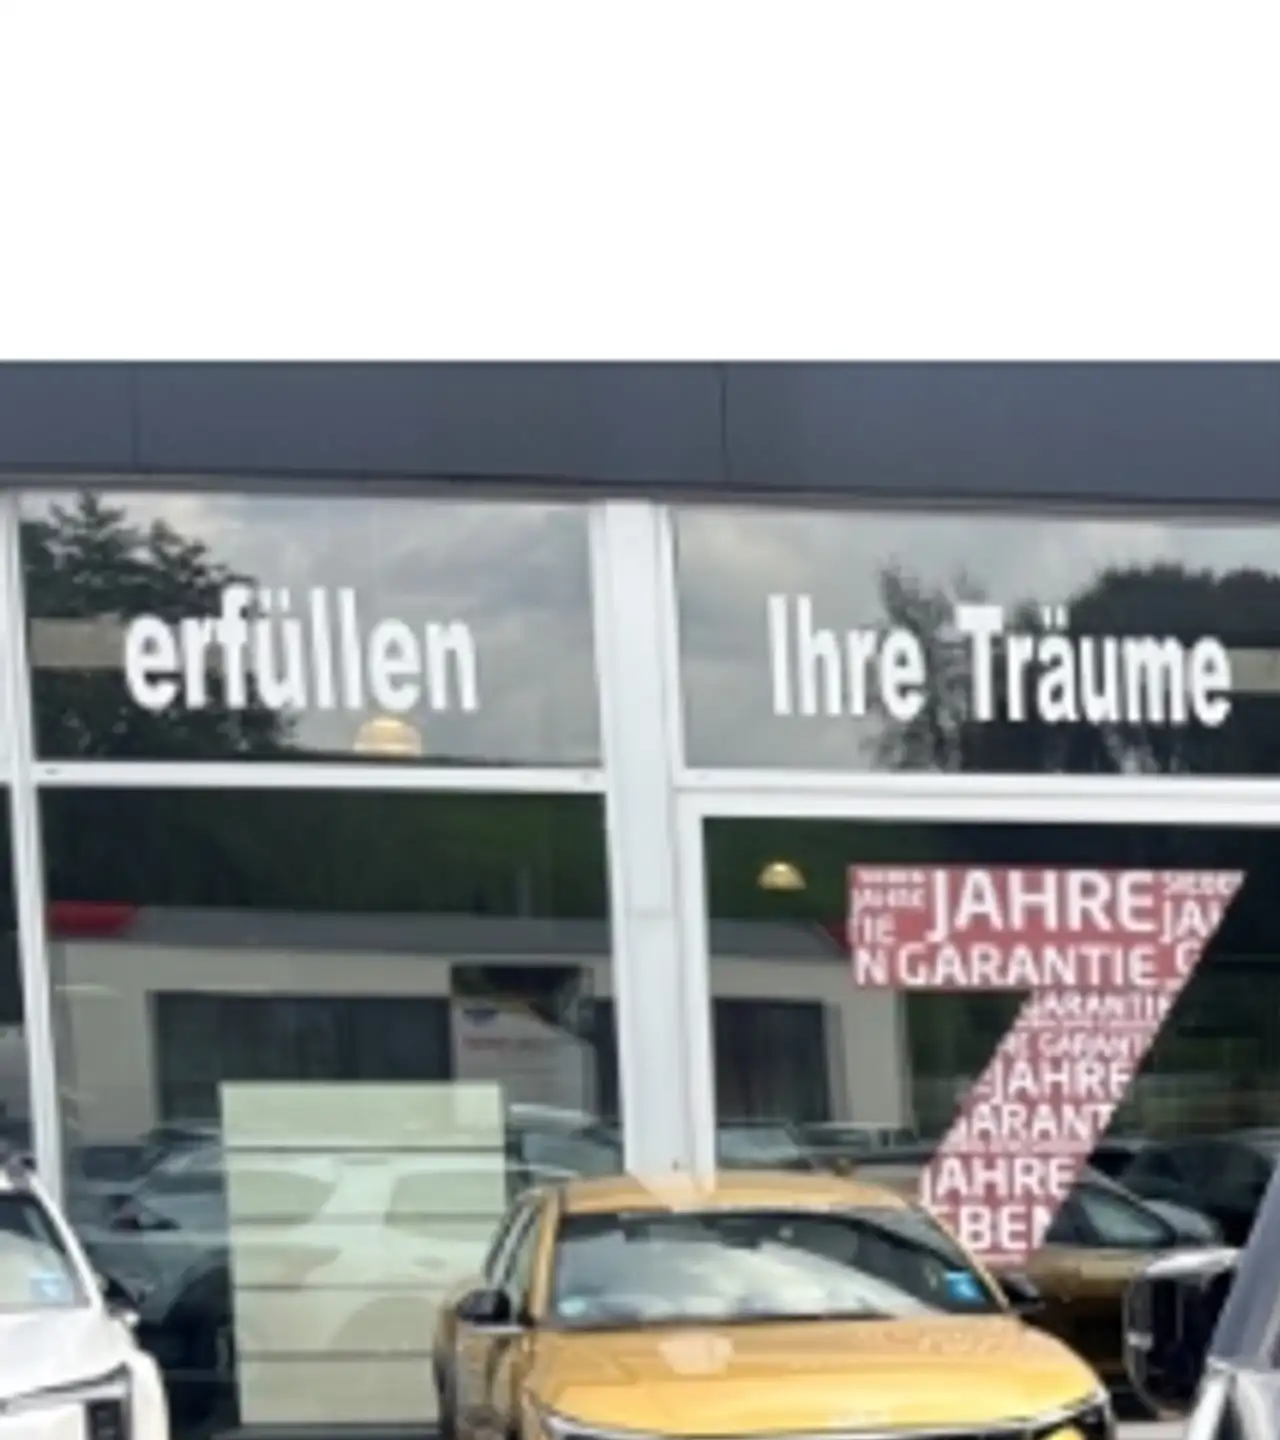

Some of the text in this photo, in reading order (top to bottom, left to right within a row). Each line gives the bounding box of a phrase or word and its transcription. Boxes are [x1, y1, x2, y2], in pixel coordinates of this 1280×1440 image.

[124, 588, 479, 711] erfüllen
[767, 595, 926, 722] Ihre
[955, 604, 1233, 727] Träume
[926, 869, 1158, 943] JAHRE
[897, 942, 1157, 987] GARANTIE
